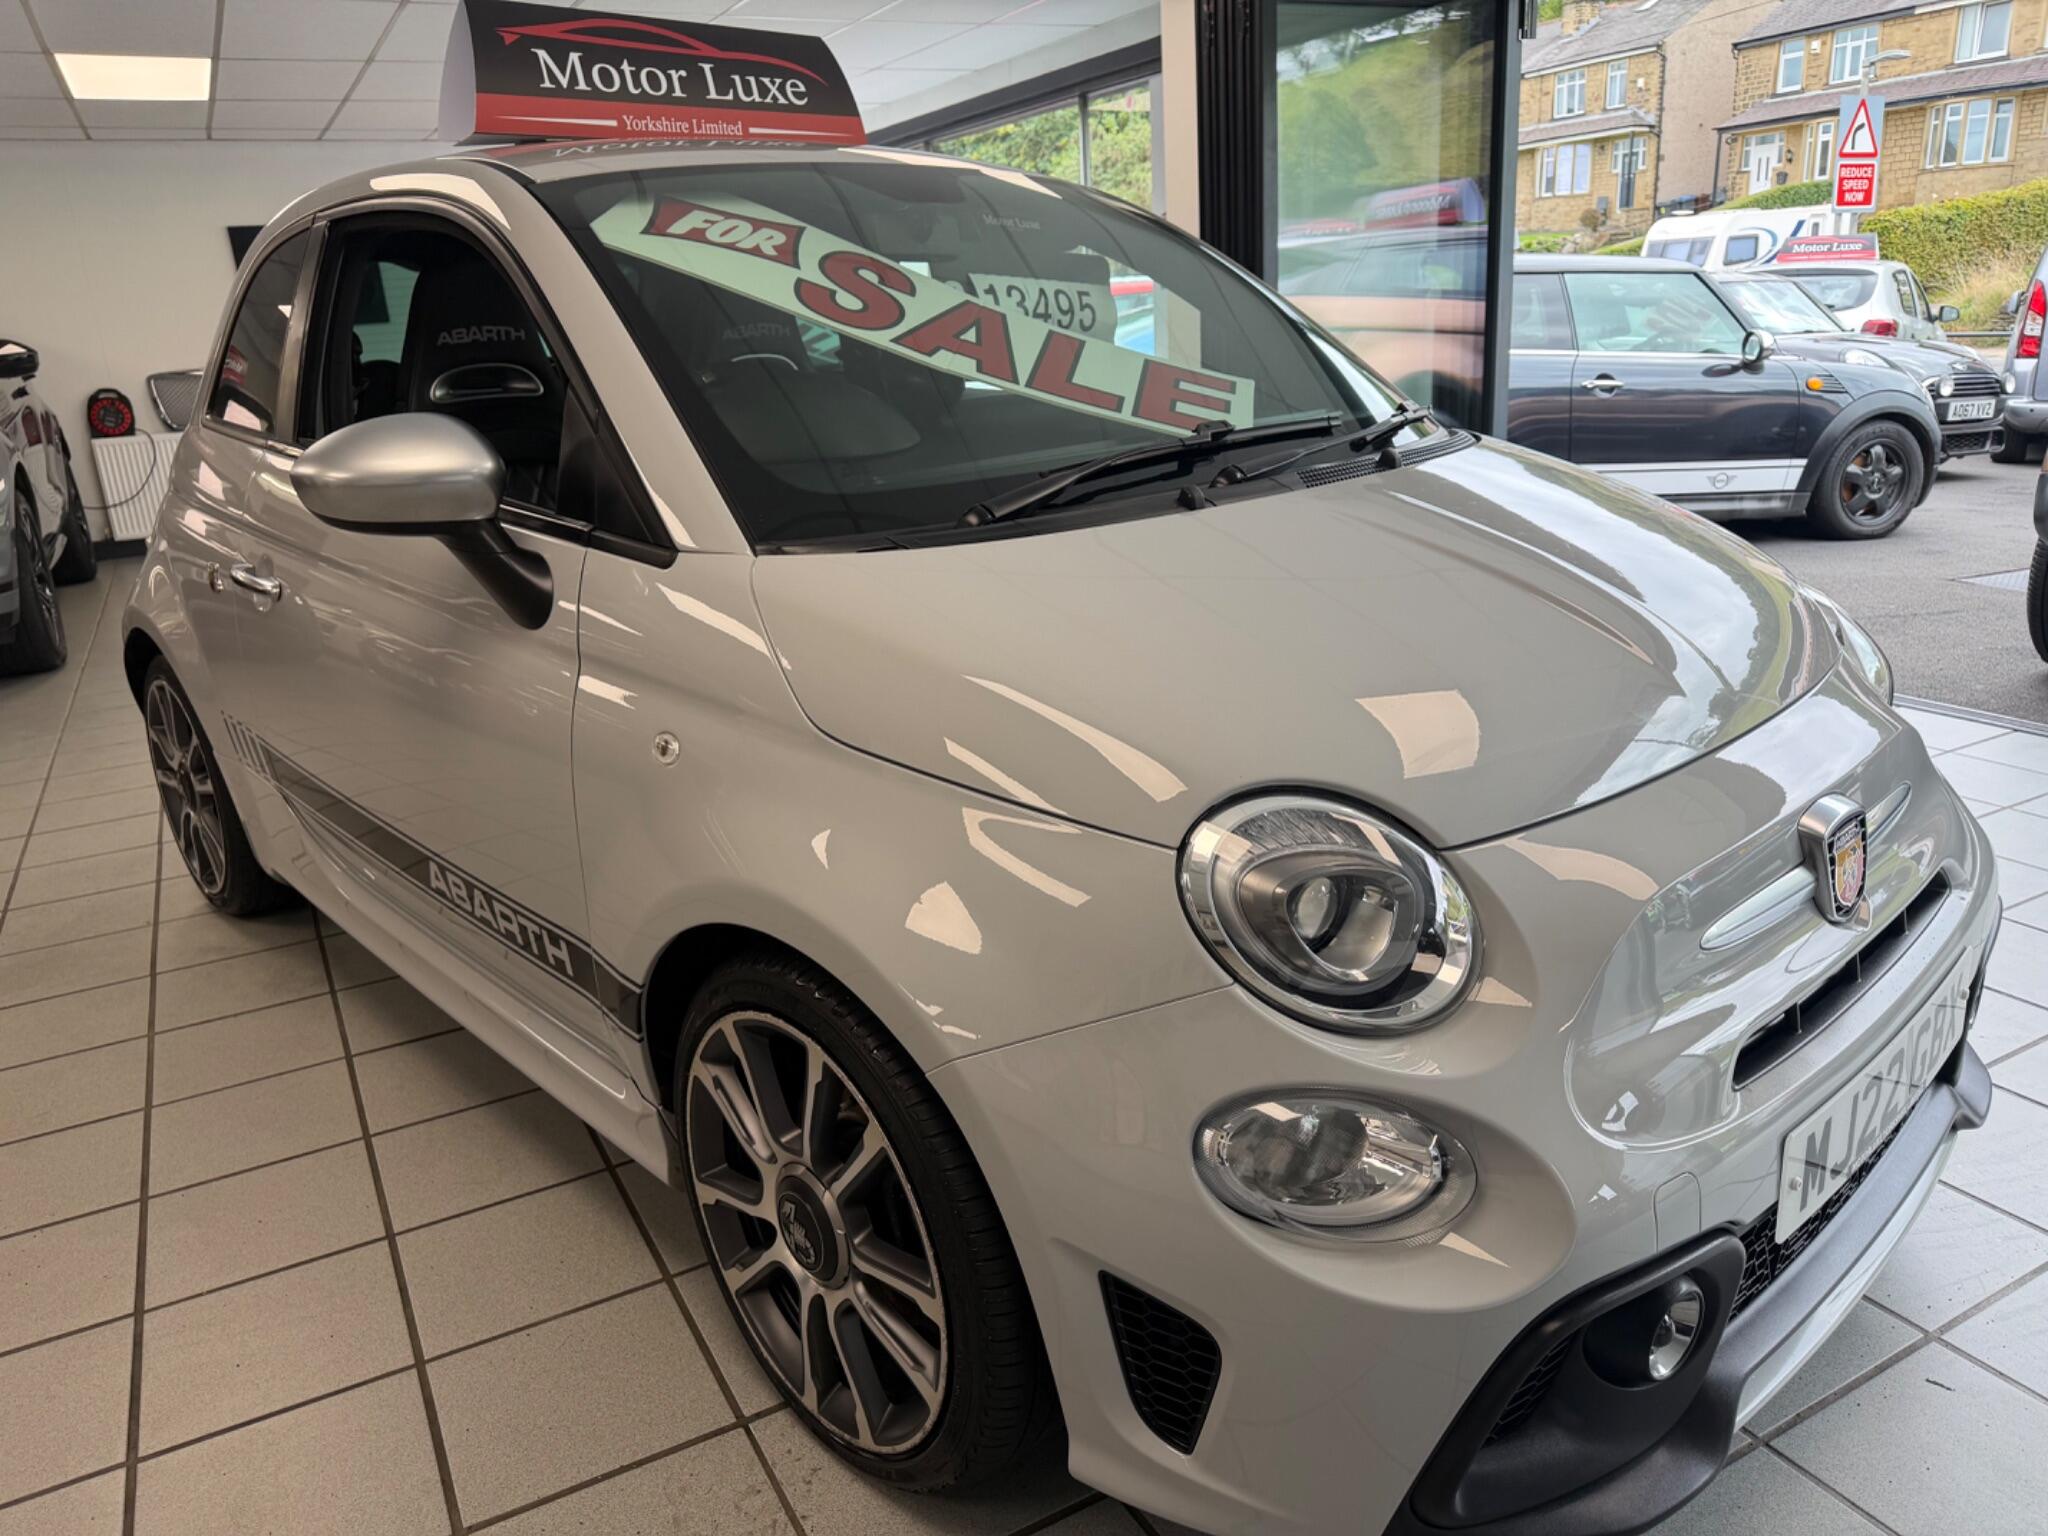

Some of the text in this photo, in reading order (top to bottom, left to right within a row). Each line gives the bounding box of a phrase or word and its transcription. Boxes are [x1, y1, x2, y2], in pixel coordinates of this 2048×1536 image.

[531, 48, 808, 106] Motor Luxe
[622, 115, 743, 136] Yorkshire Limited
[1840, 166, 1873, 178] REDUCE
[1842, 179, 1870, 190] SPEED
[1844, 191, 1866, 202] NOW
[1792, 242, 1863, 253] Motor Luxe
[666, 209, 1237, 432] FOR SALE
[436, 325, 526, 346] ABARTH
[428, 860, 574, 977] ABARTH
[1799, 1046, 1905, 1213] MJ22
